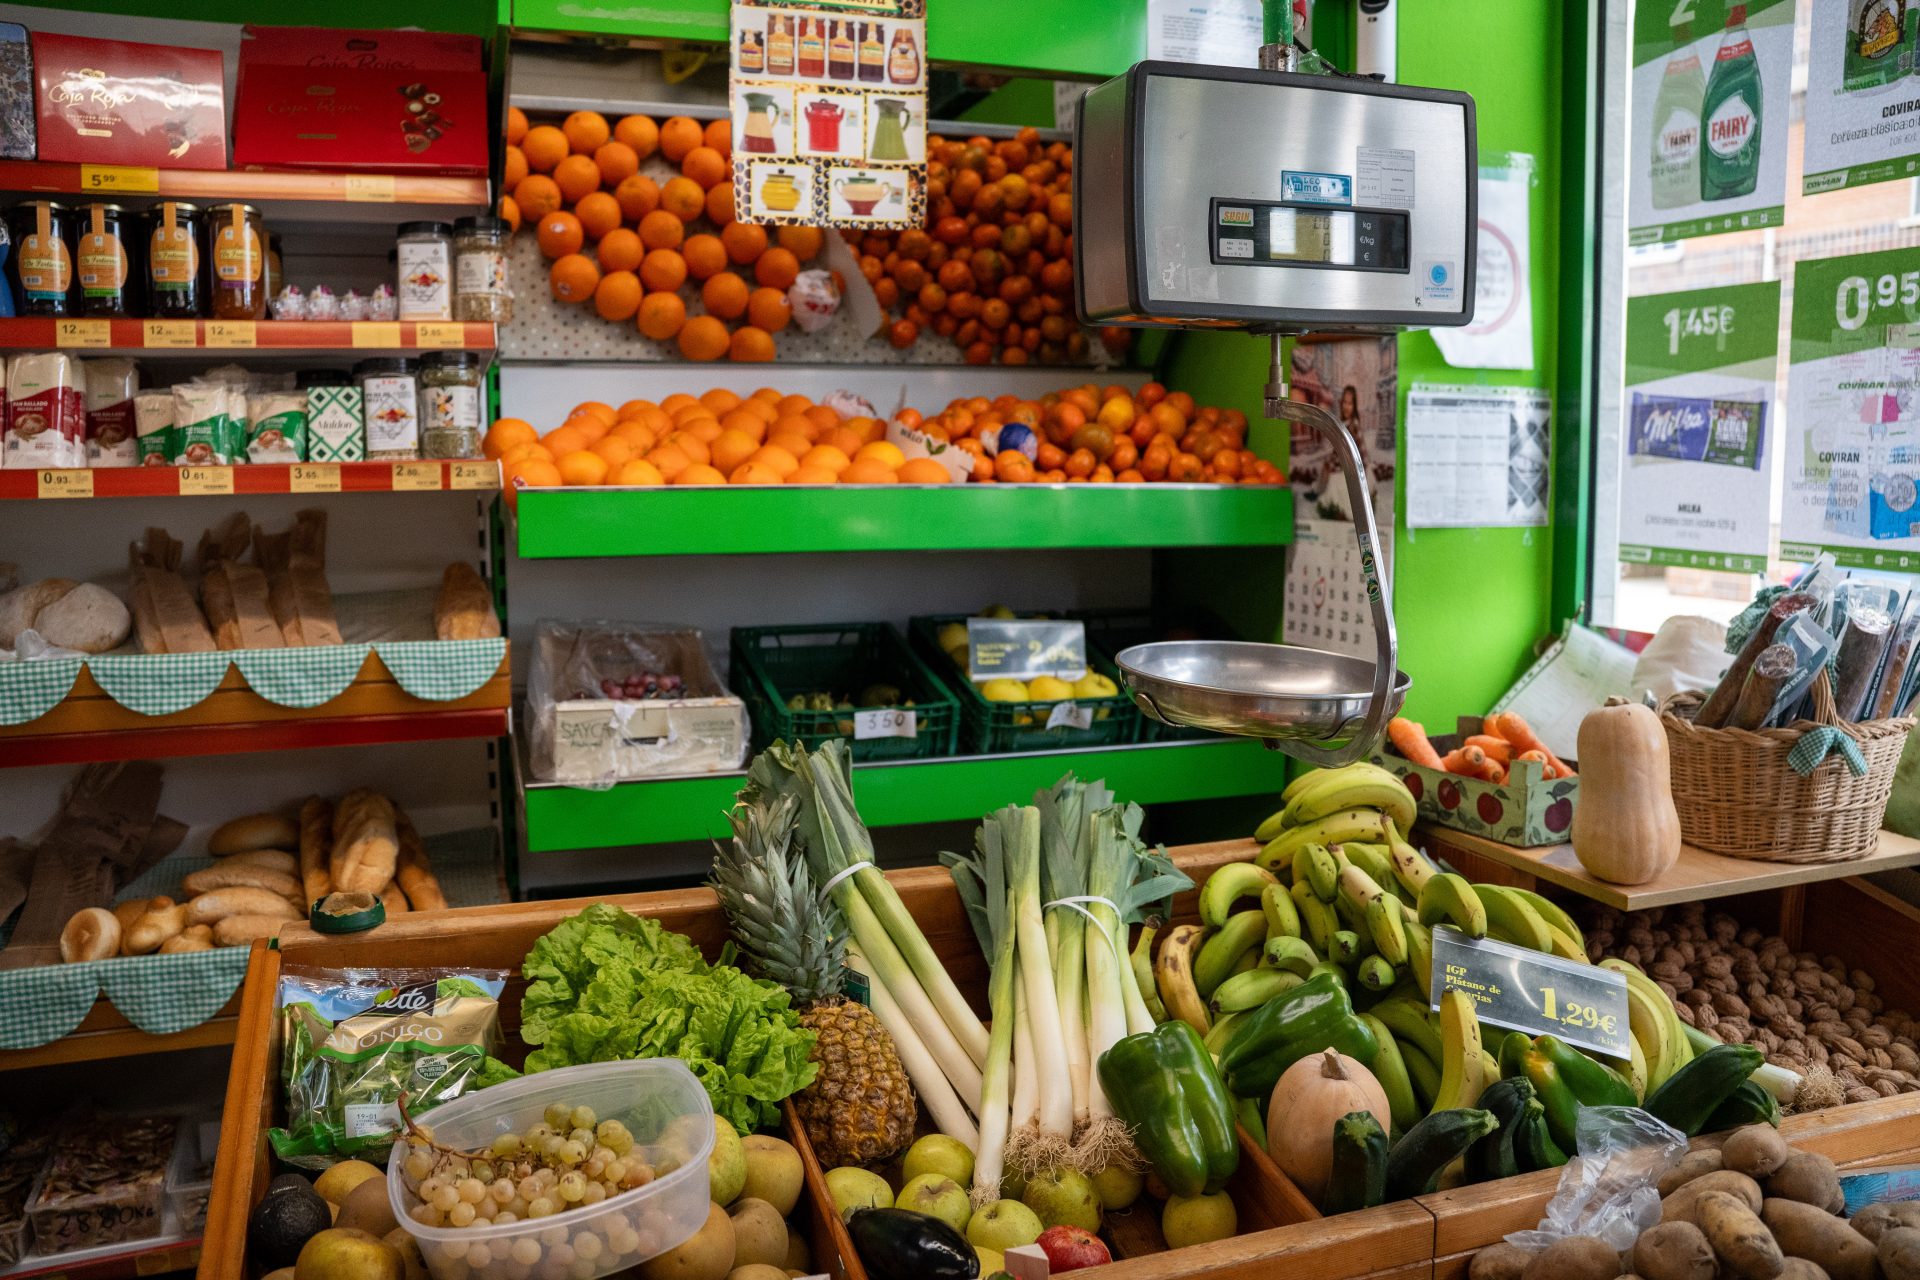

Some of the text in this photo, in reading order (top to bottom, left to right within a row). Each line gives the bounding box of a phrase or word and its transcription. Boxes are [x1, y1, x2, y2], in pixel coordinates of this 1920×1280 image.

[49, 84, 137, 110] Caja Roja
[1711, 114, 1750, 142] FAIRY
[1670, 133, 1691, 147] FAIRY
[1362, 220, 1372, 231] kg
[1359, 236, 1375, 246] €/kg
[1363, 252, 1370, 261] €
[1663, 305, 1735, 355] 1,45€
[318, 420, 353, 430] Maldon
[1644, 405, 1705, 442] Milka
[1818, 451, 1860, 463] COVIRAN
[1863, 688, 1876, 718] CHORIZO
[1446, 964, 1467, 977] IGP
[1445, 974, 1501, 996] Plátano de
[1540, 986, 1618, 1037] 1,29€
